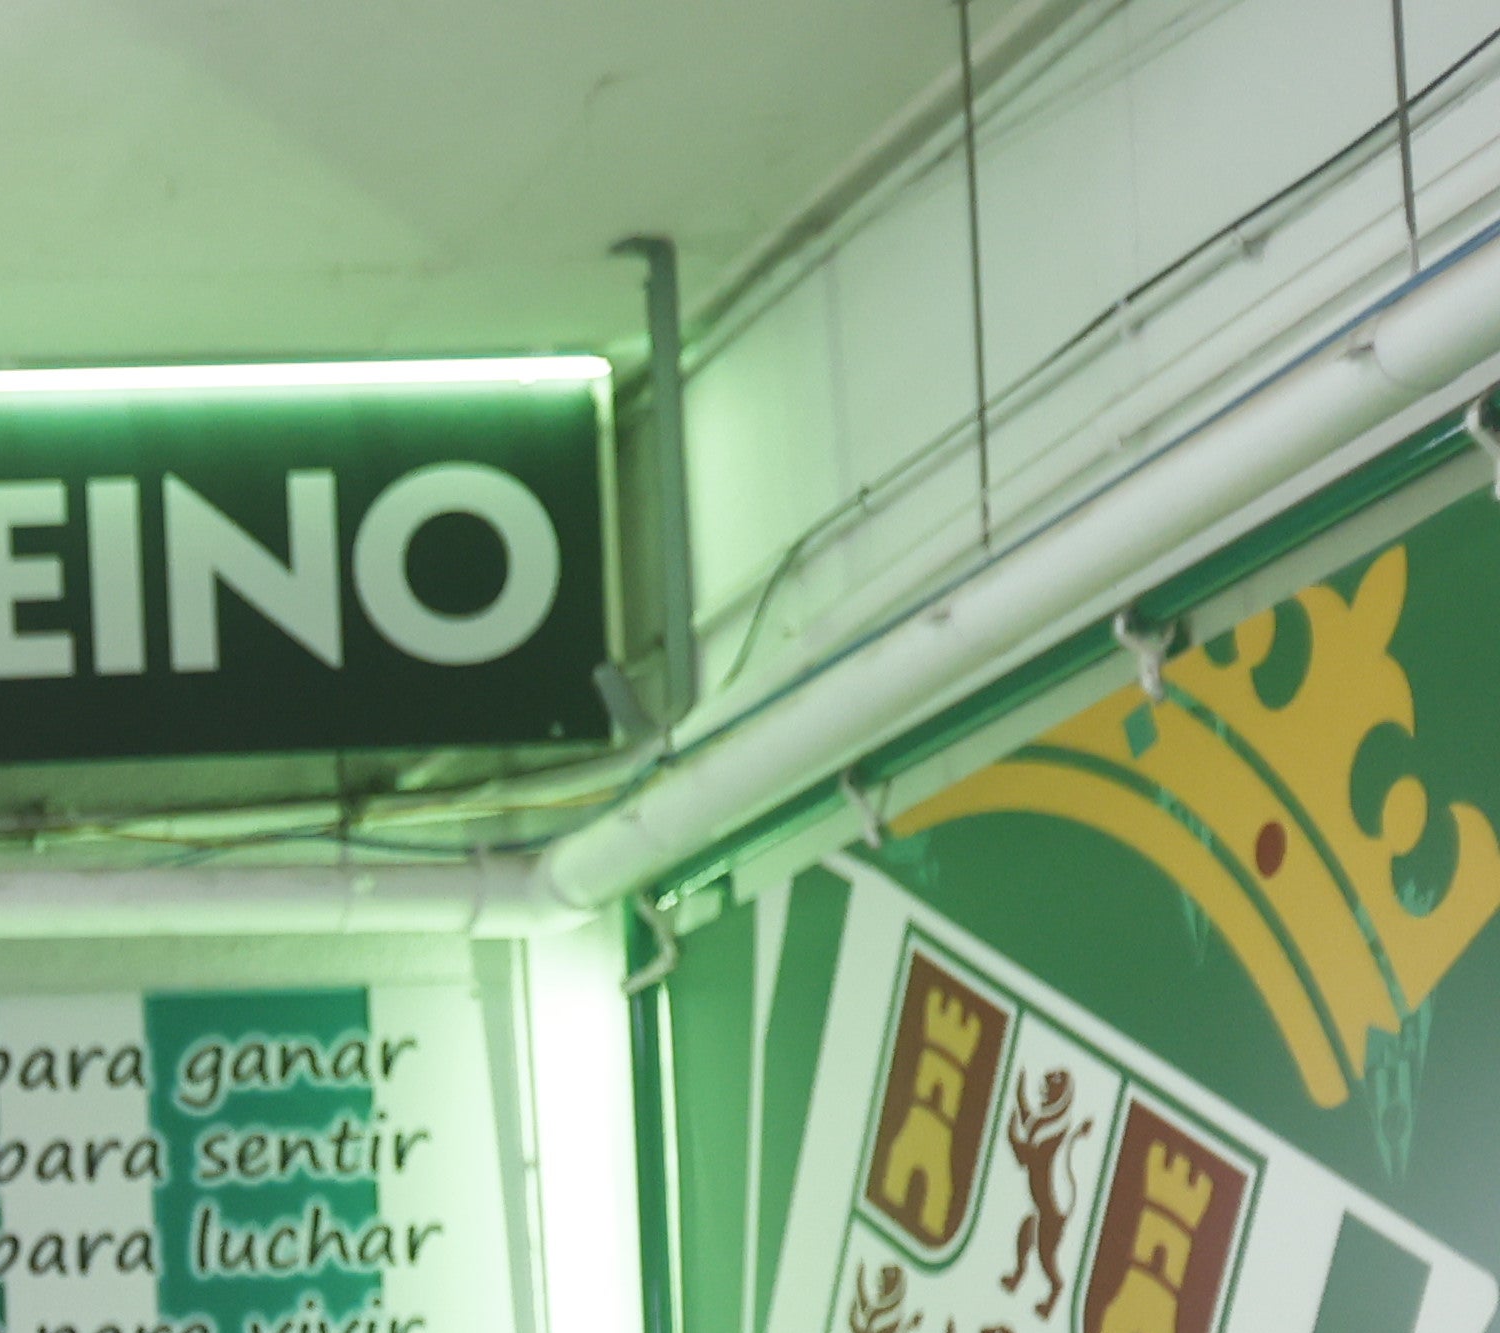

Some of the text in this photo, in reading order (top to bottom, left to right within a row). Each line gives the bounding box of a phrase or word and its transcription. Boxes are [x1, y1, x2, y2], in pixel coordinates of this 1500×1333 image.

[176, 1033, 417, 1110] ganar
[197, 1112, 432, 1179] sentir
[194, 1205, 443, 1275] luchar
